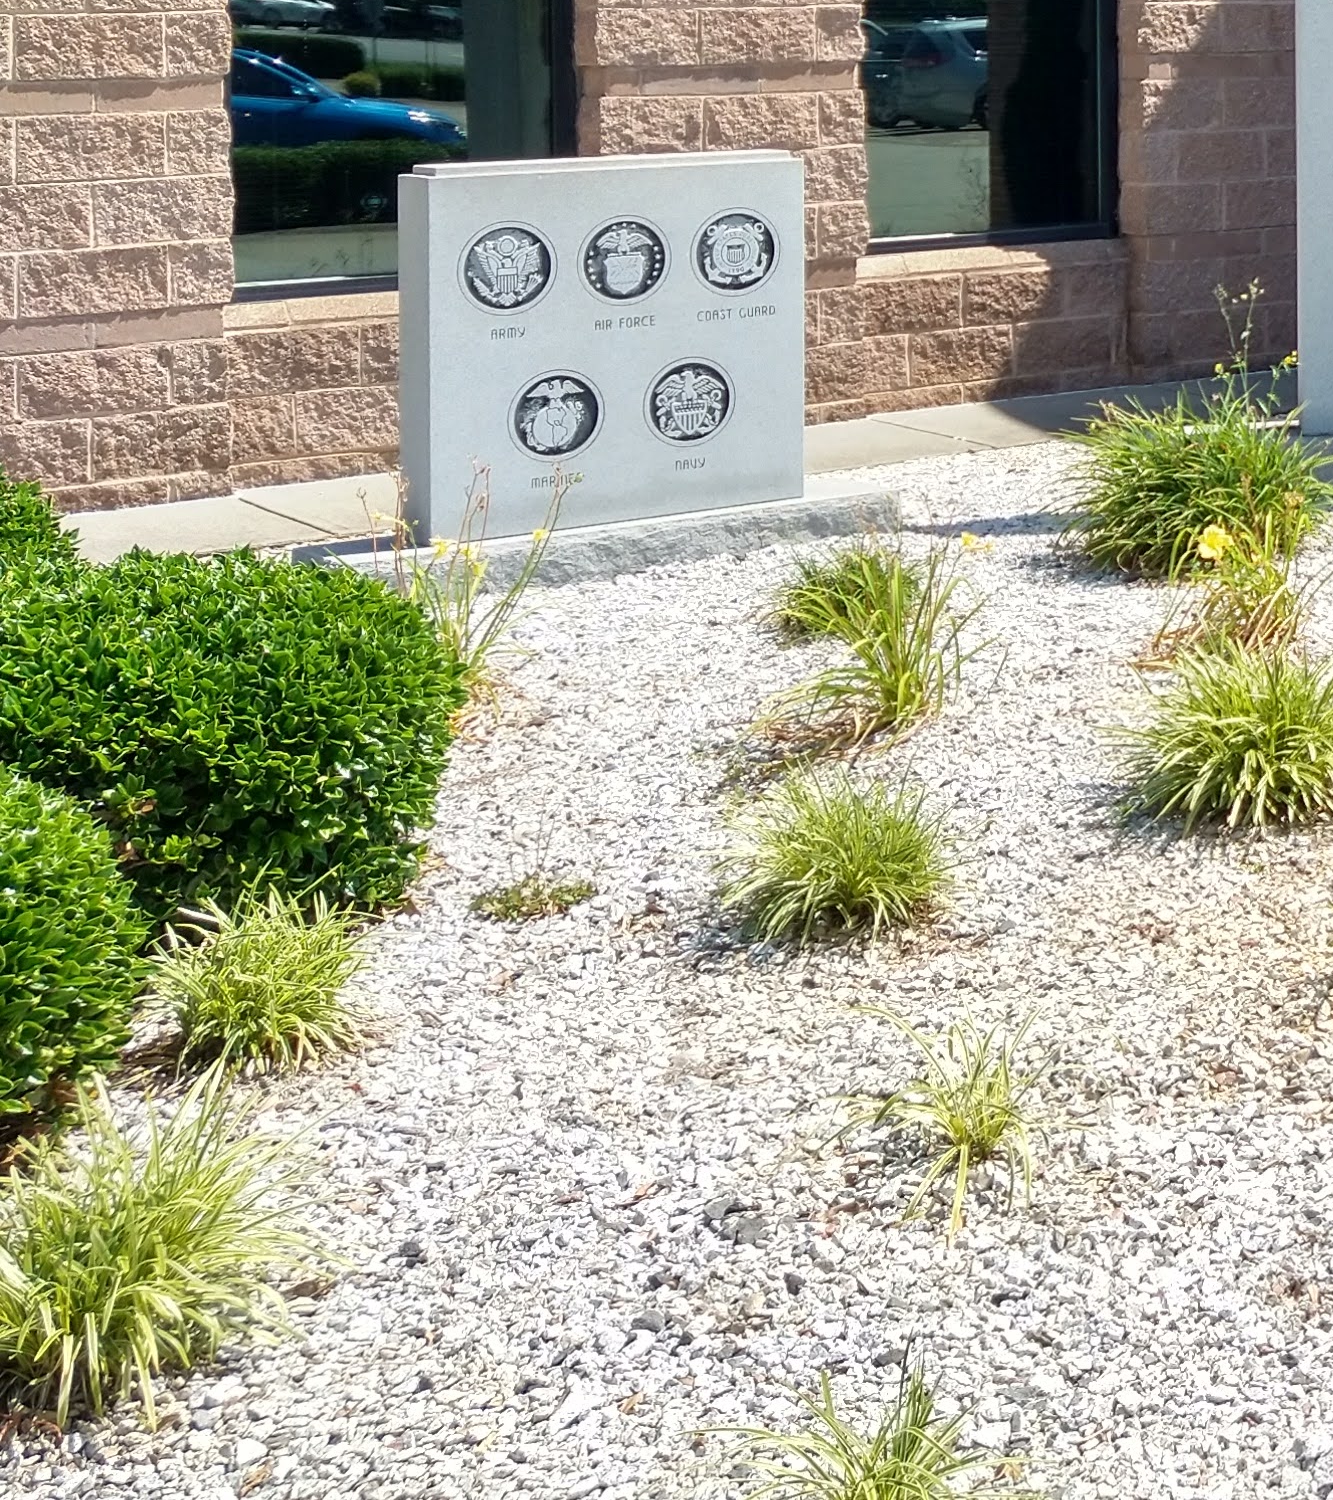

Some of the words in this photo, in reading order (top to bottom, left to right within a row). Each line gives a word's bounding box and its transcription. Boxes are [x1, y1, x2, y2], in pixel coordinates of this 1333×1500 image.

[697, 309, 732, 321] COAST
[739, 305, 775, 319] GUARD
[594, 320, 612, 331] AIR
[619, 315, 656, 328] FORCE
[491, 327, 525, 340] ARMY
[675, 457, 705, 471] NAVY
[531, 472, 584, 488] MARNE
